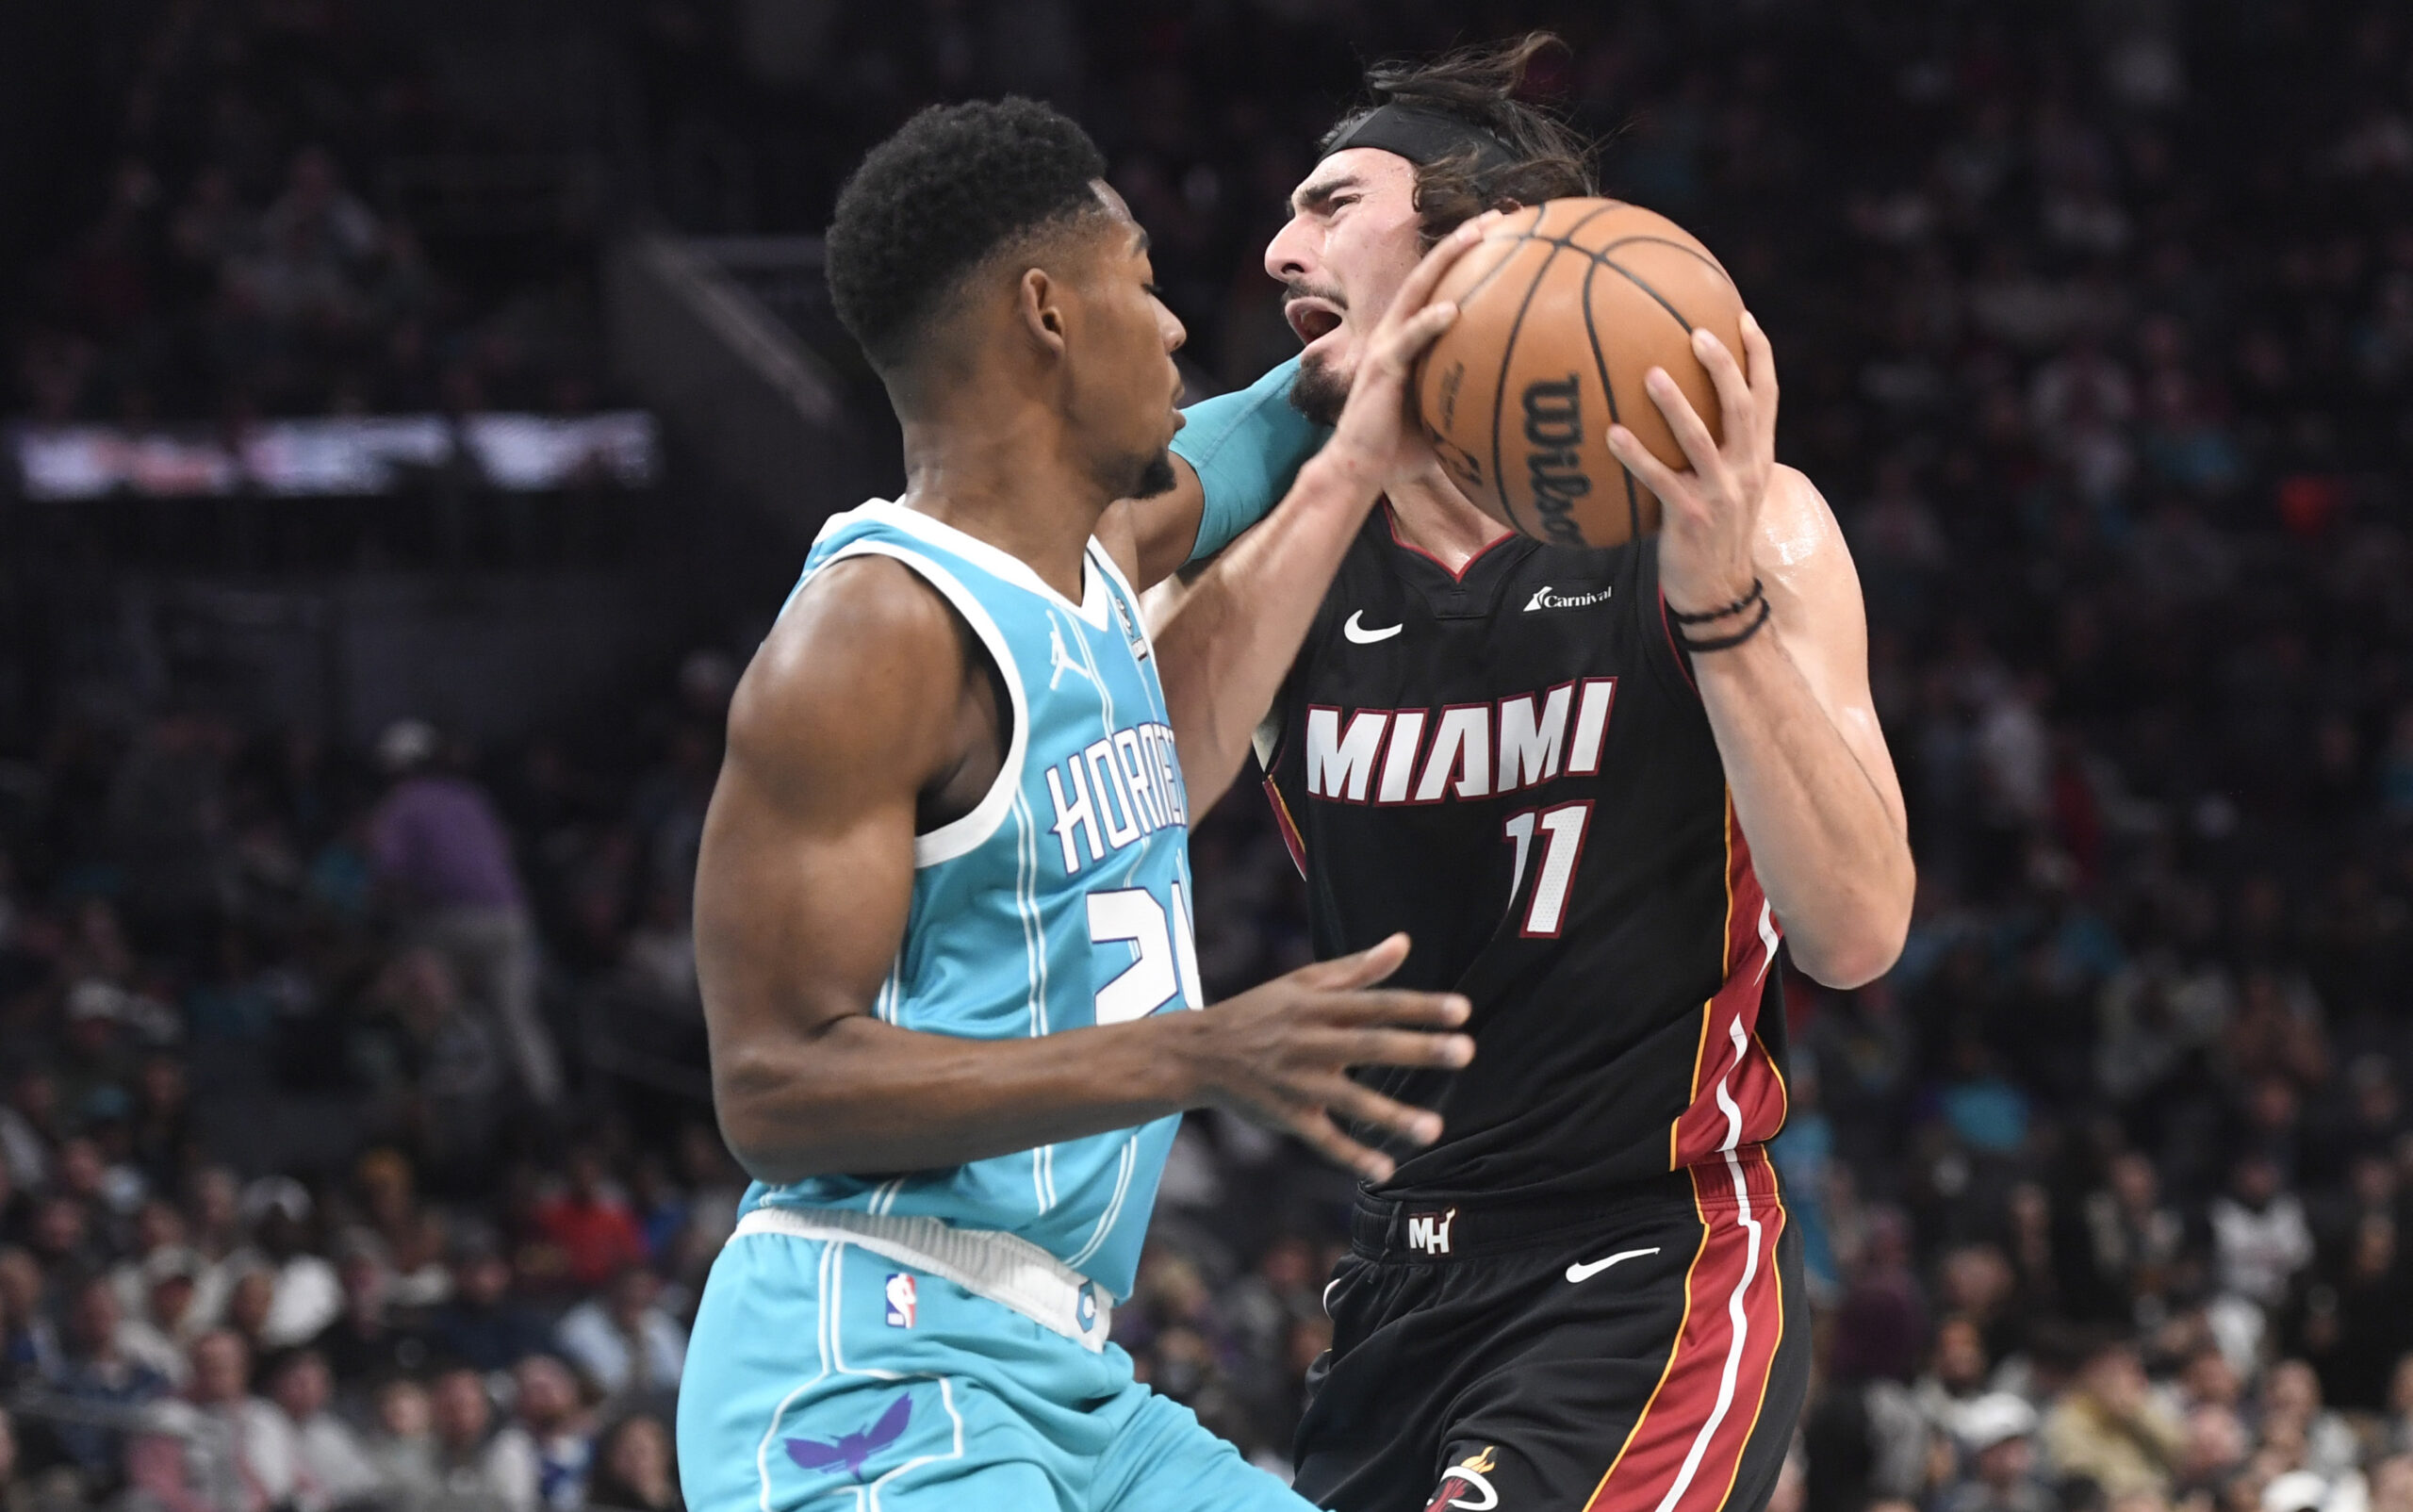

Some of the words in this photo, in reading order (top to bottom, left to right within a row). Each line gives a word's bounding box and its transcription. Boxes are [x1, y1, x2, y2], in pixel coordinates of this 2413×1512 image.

[1521, 372, 1593, 546] Wilso
[1543, 585, 1613, 608] Carnival
[1305, 676, 1619, 808] MIAMI
[1502, 799, 1596, 940] 11
